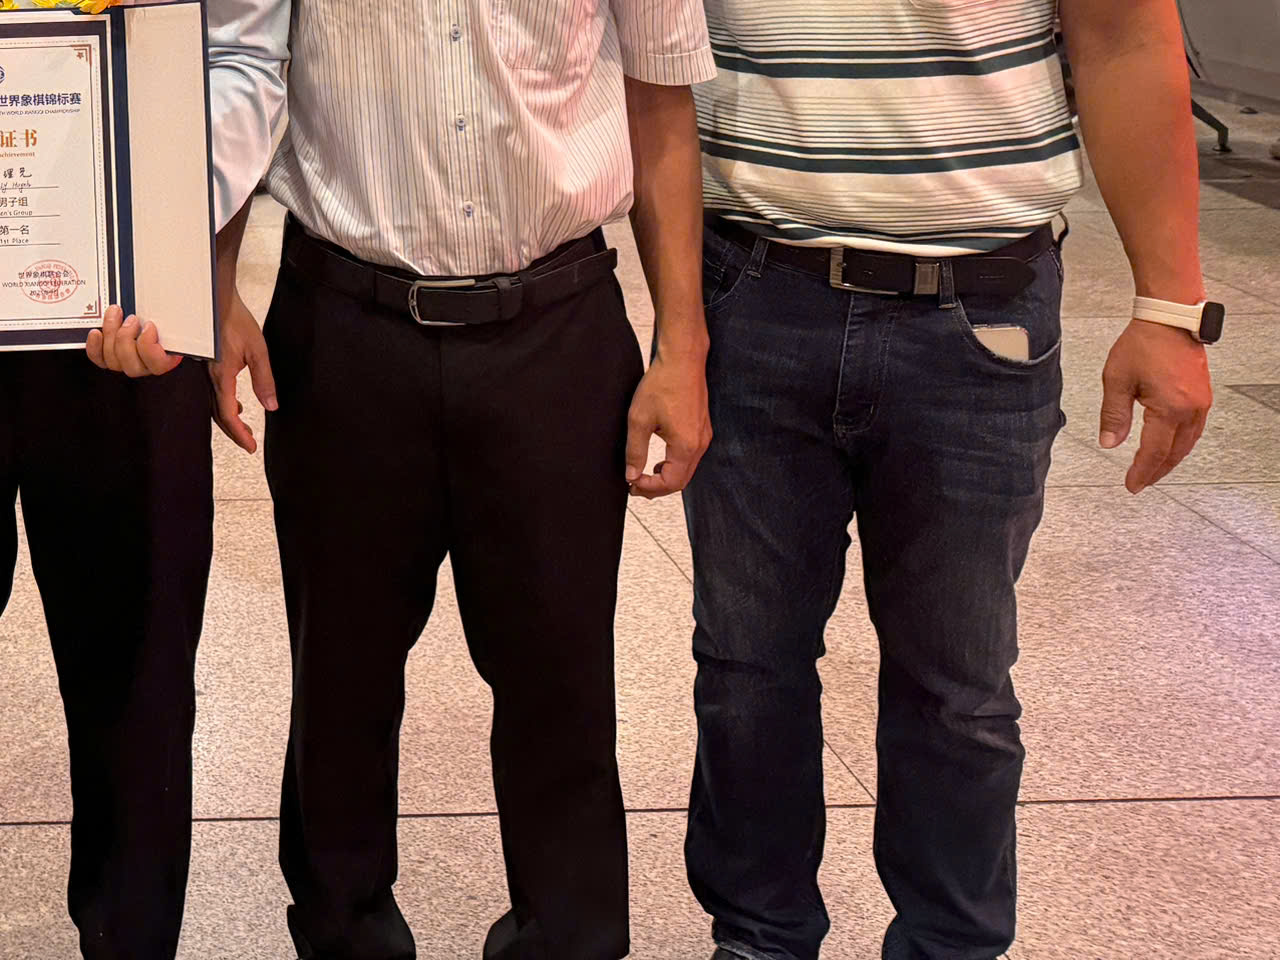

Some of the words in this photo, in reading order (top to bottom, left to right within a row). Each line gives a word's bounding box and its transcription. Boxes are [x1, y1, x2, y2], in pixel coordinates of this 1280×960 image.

[13, 209, 33, 217] Group
[0, 224, 30, 236] 第一名
